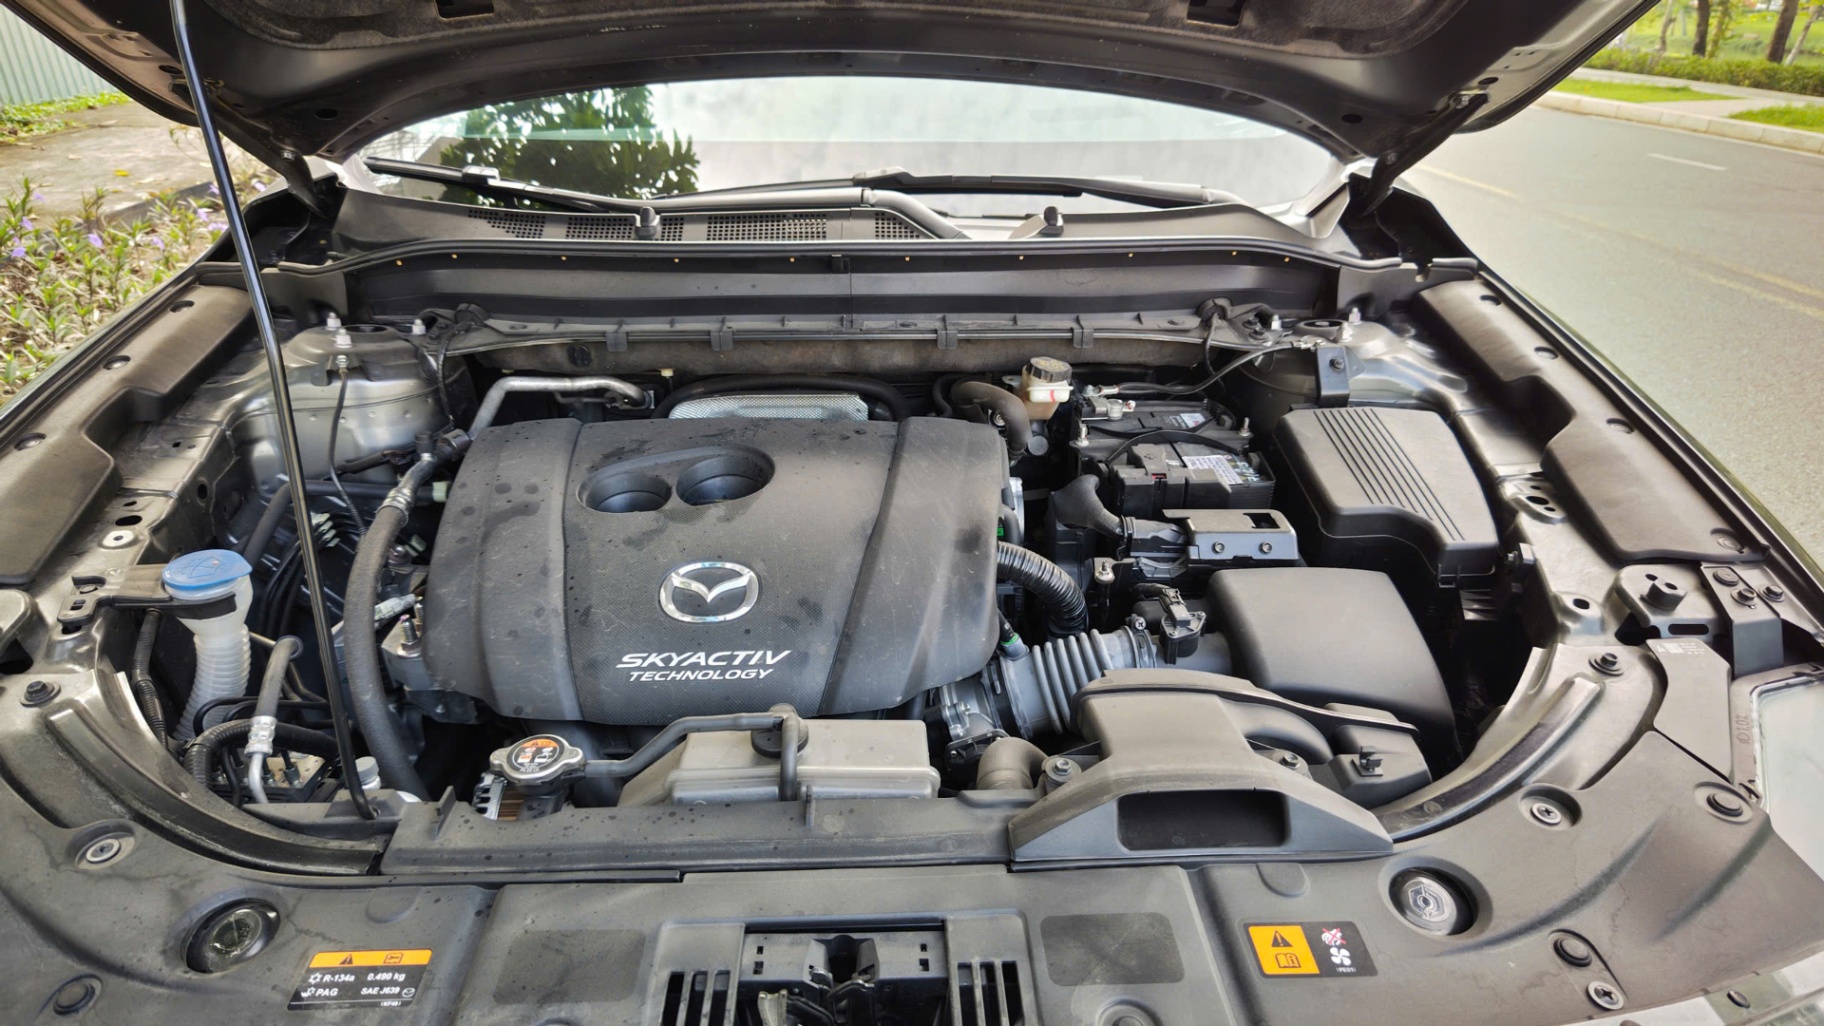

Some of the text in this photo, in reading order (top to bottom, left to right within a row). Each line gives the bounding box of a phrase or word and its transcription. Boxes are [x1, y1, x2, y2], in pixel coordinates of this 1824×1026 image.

[615, 650, 791, 668] SKYACTIV
[628, 669, 774, 682] TECHNOLOGY
[322, 972, 406, 982] R-134a 0.490 kg
[315, 986, 400, 996] PAG SAE J639
